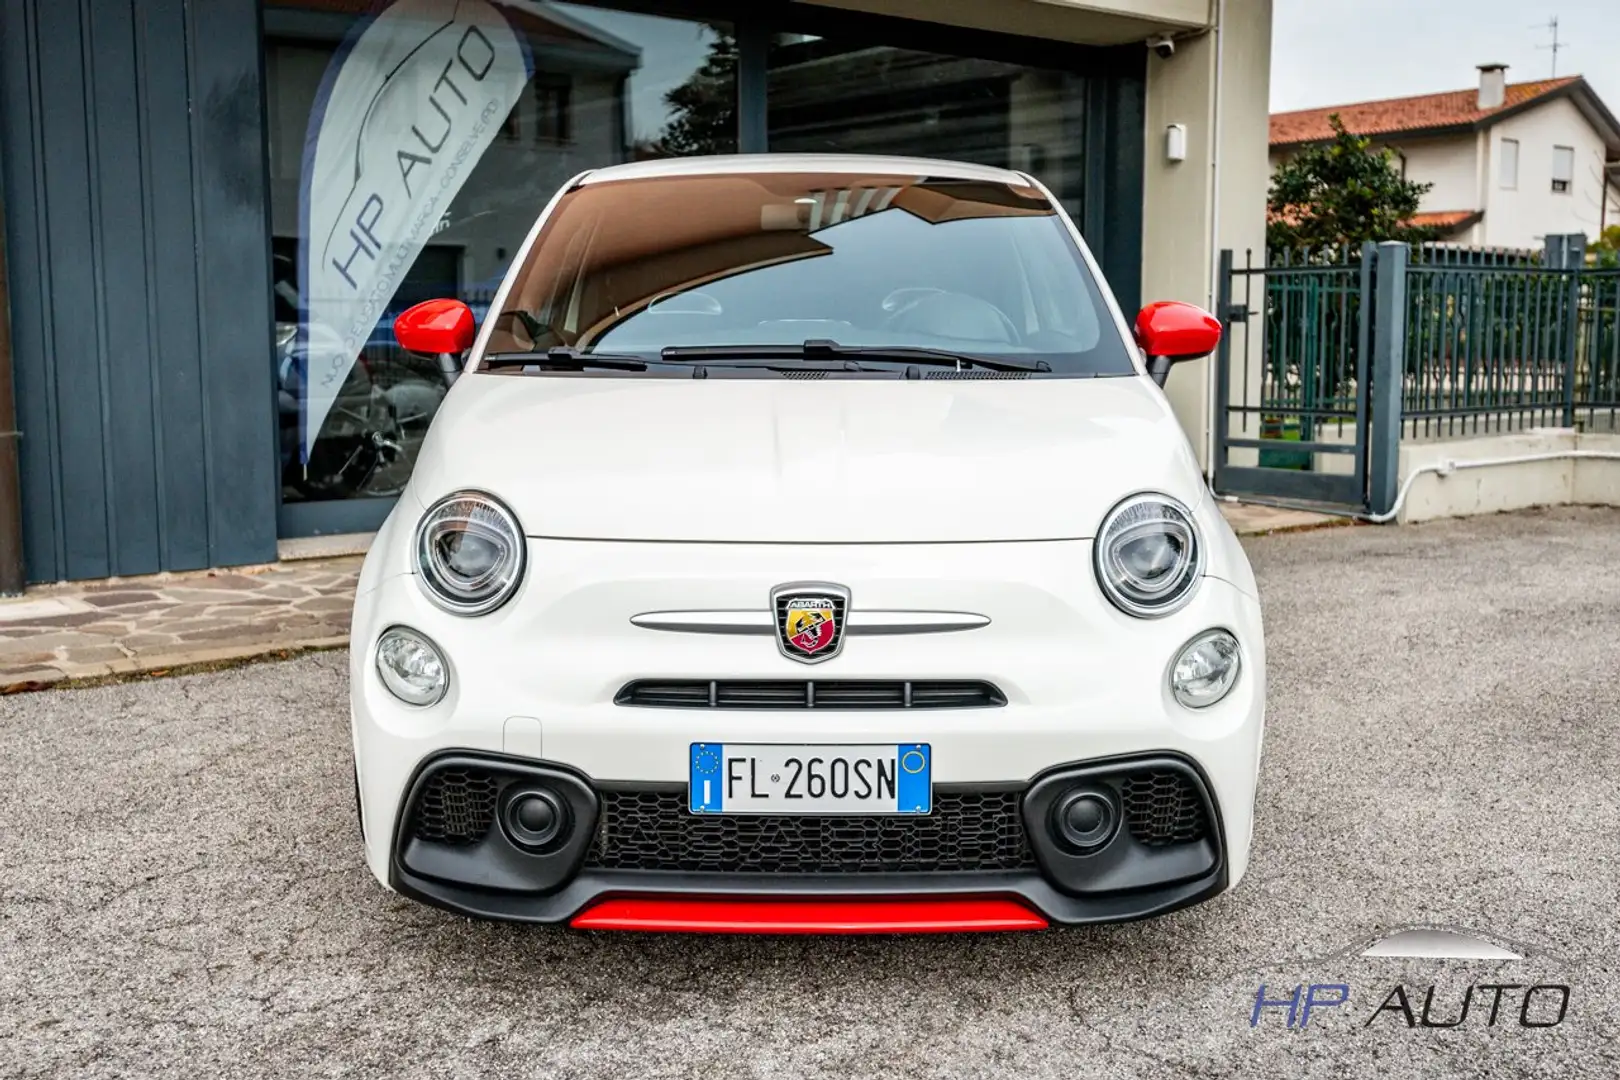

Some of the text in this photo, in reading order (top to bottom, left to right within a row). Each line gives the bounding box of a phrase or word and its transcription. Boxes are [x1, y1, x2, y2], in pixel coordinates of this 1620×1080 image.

[332, 25, 495, 290] HP AUTO
[790, 600, 831, 609] ABARTH
